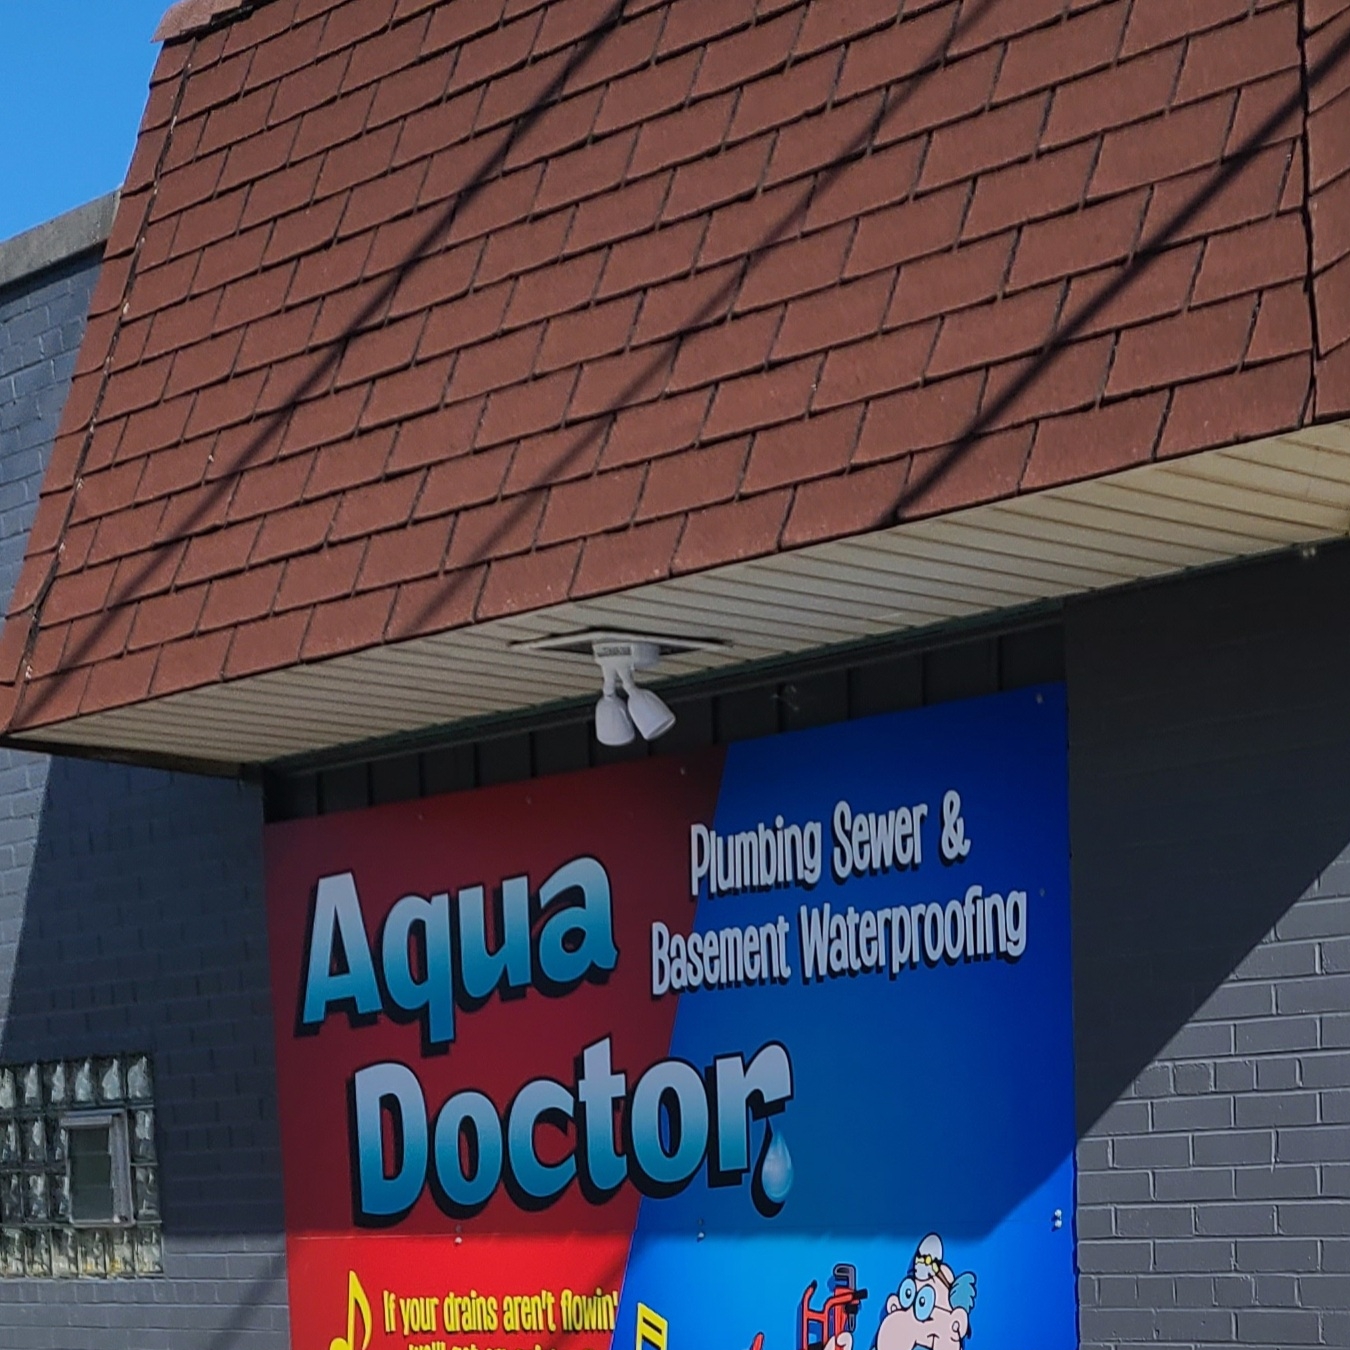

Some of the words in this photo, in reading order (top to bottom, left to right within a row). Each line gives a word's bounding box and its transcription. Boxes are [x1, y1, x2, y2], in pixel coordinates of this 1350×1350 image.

[691, 815, 821, 895] Plumbing
[832, 801, 928, 878] Sewer
[941, 790, 971, 859] &
[302, 856, 619, 1044] Aqua
[652, 916, 791, 995] Basement
[800, 885, 1026, 978] Waterproofing
[355, 1036, 793, 1216] Doctor
[383, 1290, 396, 1332] If
[400, 1296, 439, 1335] your
[444, 1290, 498, 1332] drains
[503, 1290, 556, 1332] aren't
[561, 1288, 618, 1331] flowin'
